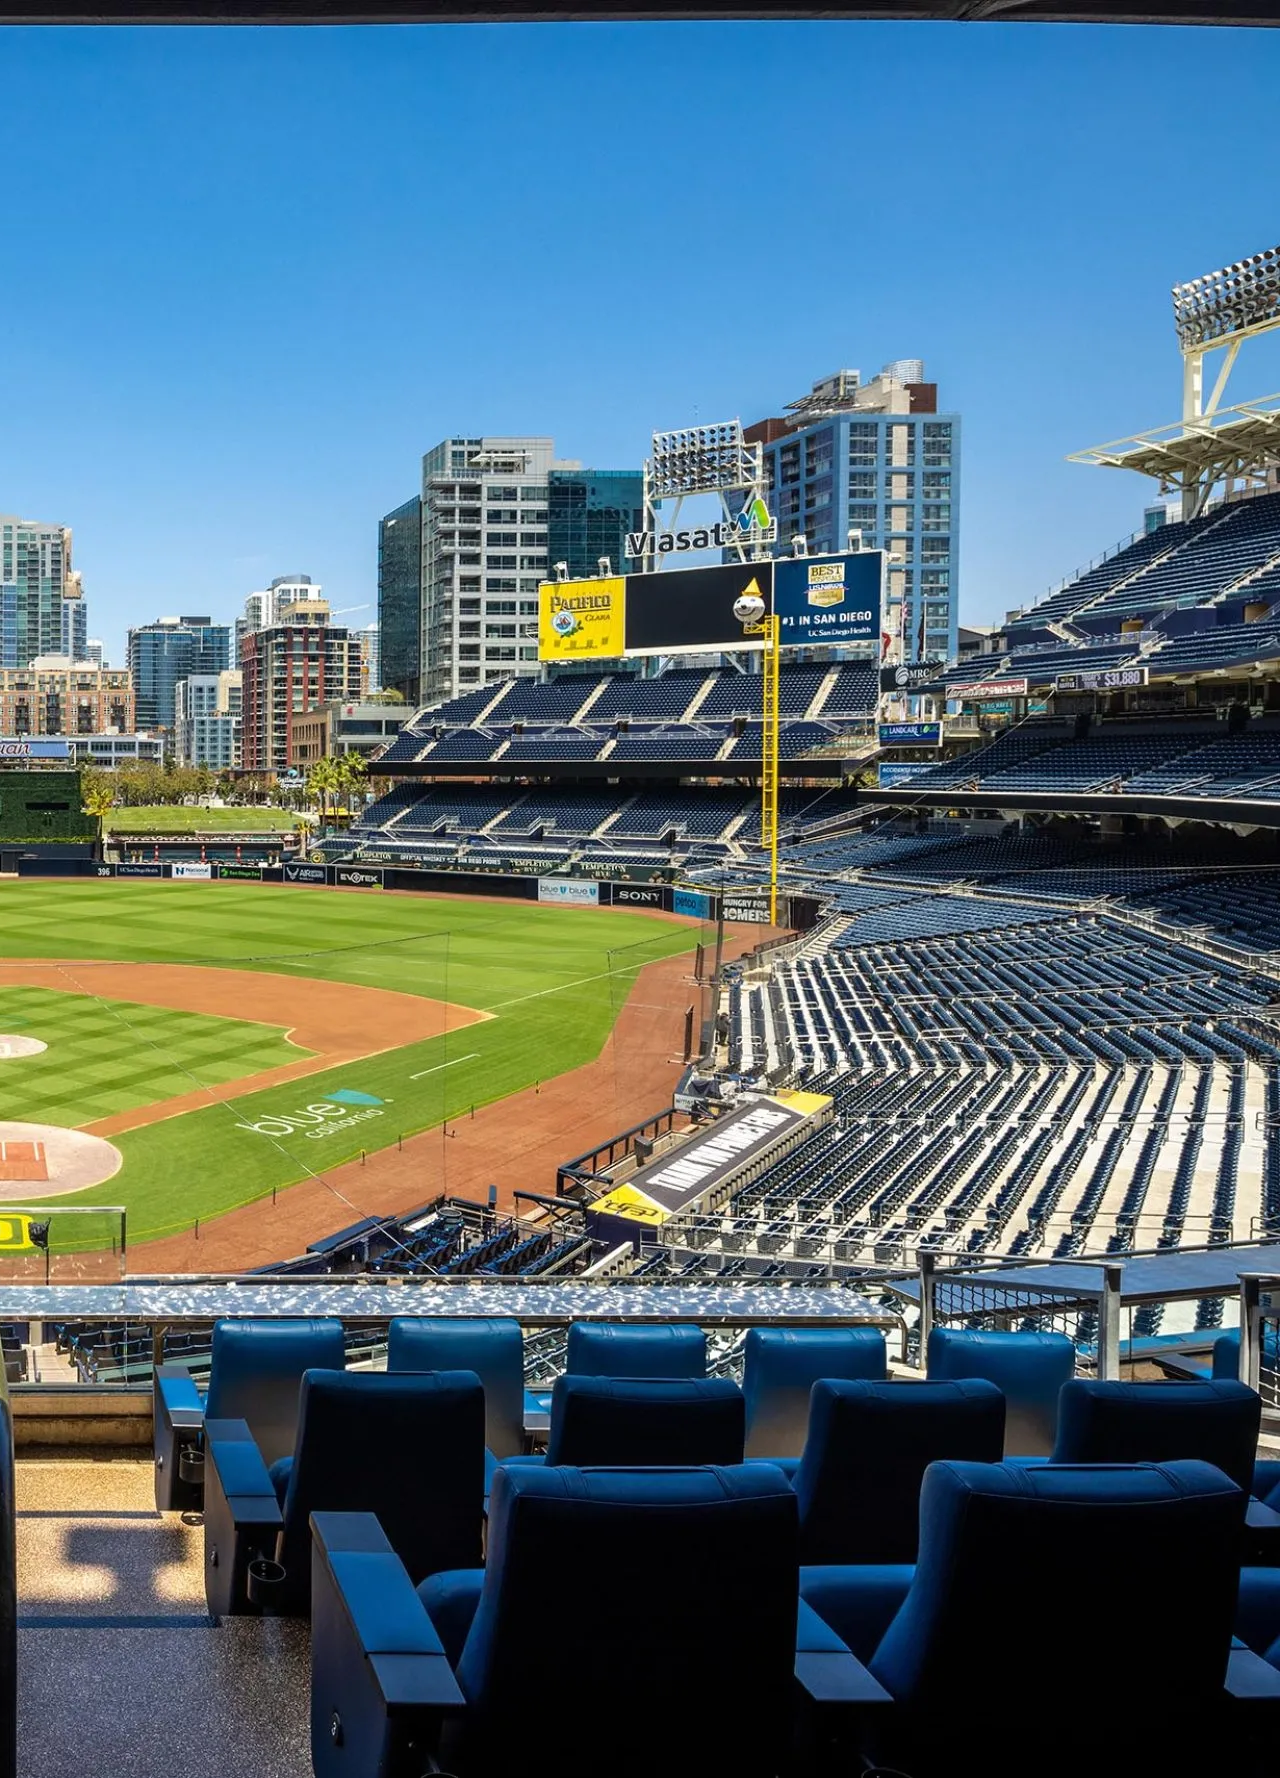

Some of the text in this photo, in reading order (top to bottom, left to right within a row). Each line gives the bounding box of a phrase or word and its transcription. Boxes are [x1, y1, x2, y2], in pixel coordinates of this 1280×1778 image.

[628, 523, 726, 556] Viasat
[811, 564, 842, 577] BEST
[782, 610, 872, 626] #1 IN SAN DIEGO
[832, 628, 850, 636] Diego
[850, 626, 872, 634] Health
[909, 668, 930, 679] MRC
[1104, 670, 1140, 686] $31,880
[97, 867, 110, 876] 396
[580, 863, 626, 873] TEMPLETON
[540, 885, 588, 895] blue blue
[619, 890, 660, 902] SONY
[723, 898, 768, 909] HUNGRY FOR
[234, 1103, 347, 1137] blue
[304, 1107, 385, 1139] california
